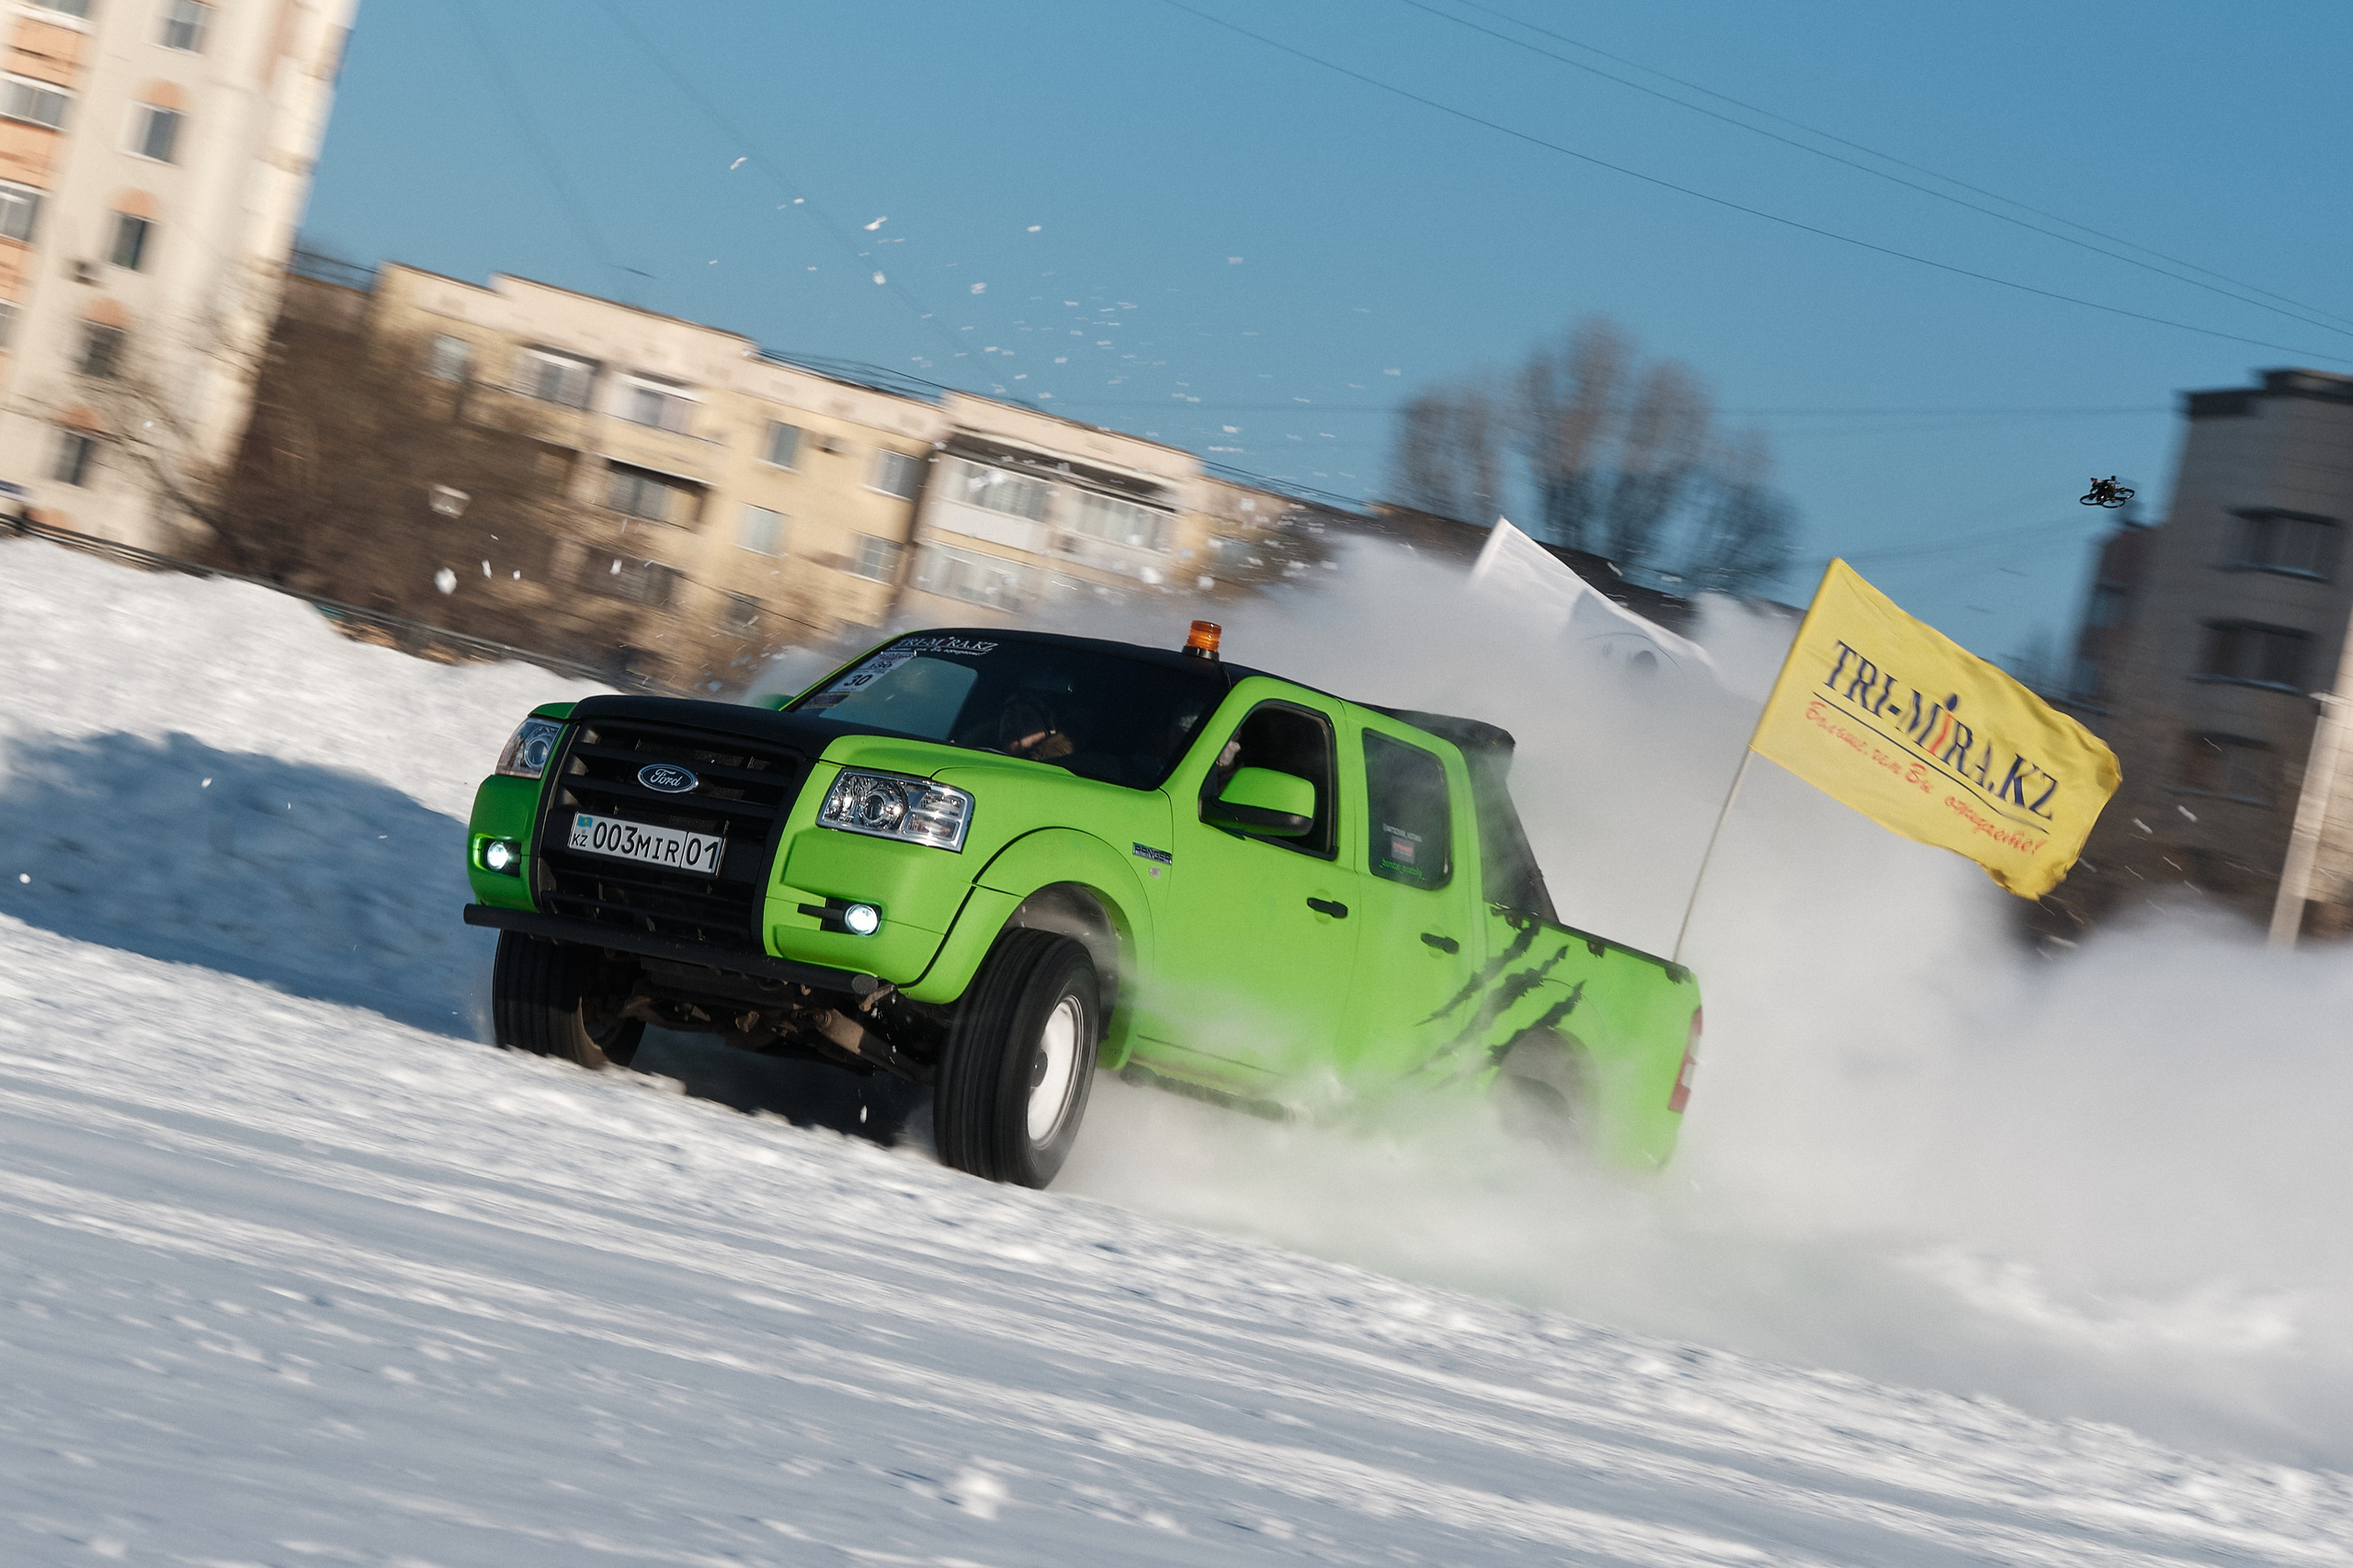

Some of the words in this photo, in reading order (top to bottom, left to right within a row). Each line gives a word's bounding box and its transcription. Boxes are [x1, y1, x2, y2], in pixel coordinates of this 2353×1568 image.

[844, 674, 873, 687] 30
[650, 768, 681, 788] Ford
[1904, 762, 1934, 794] Вы
[572, 833, 588, 847] KZ
[593, 822, 680, 863] 003MIR
[686, 837, 719, 869] 01
